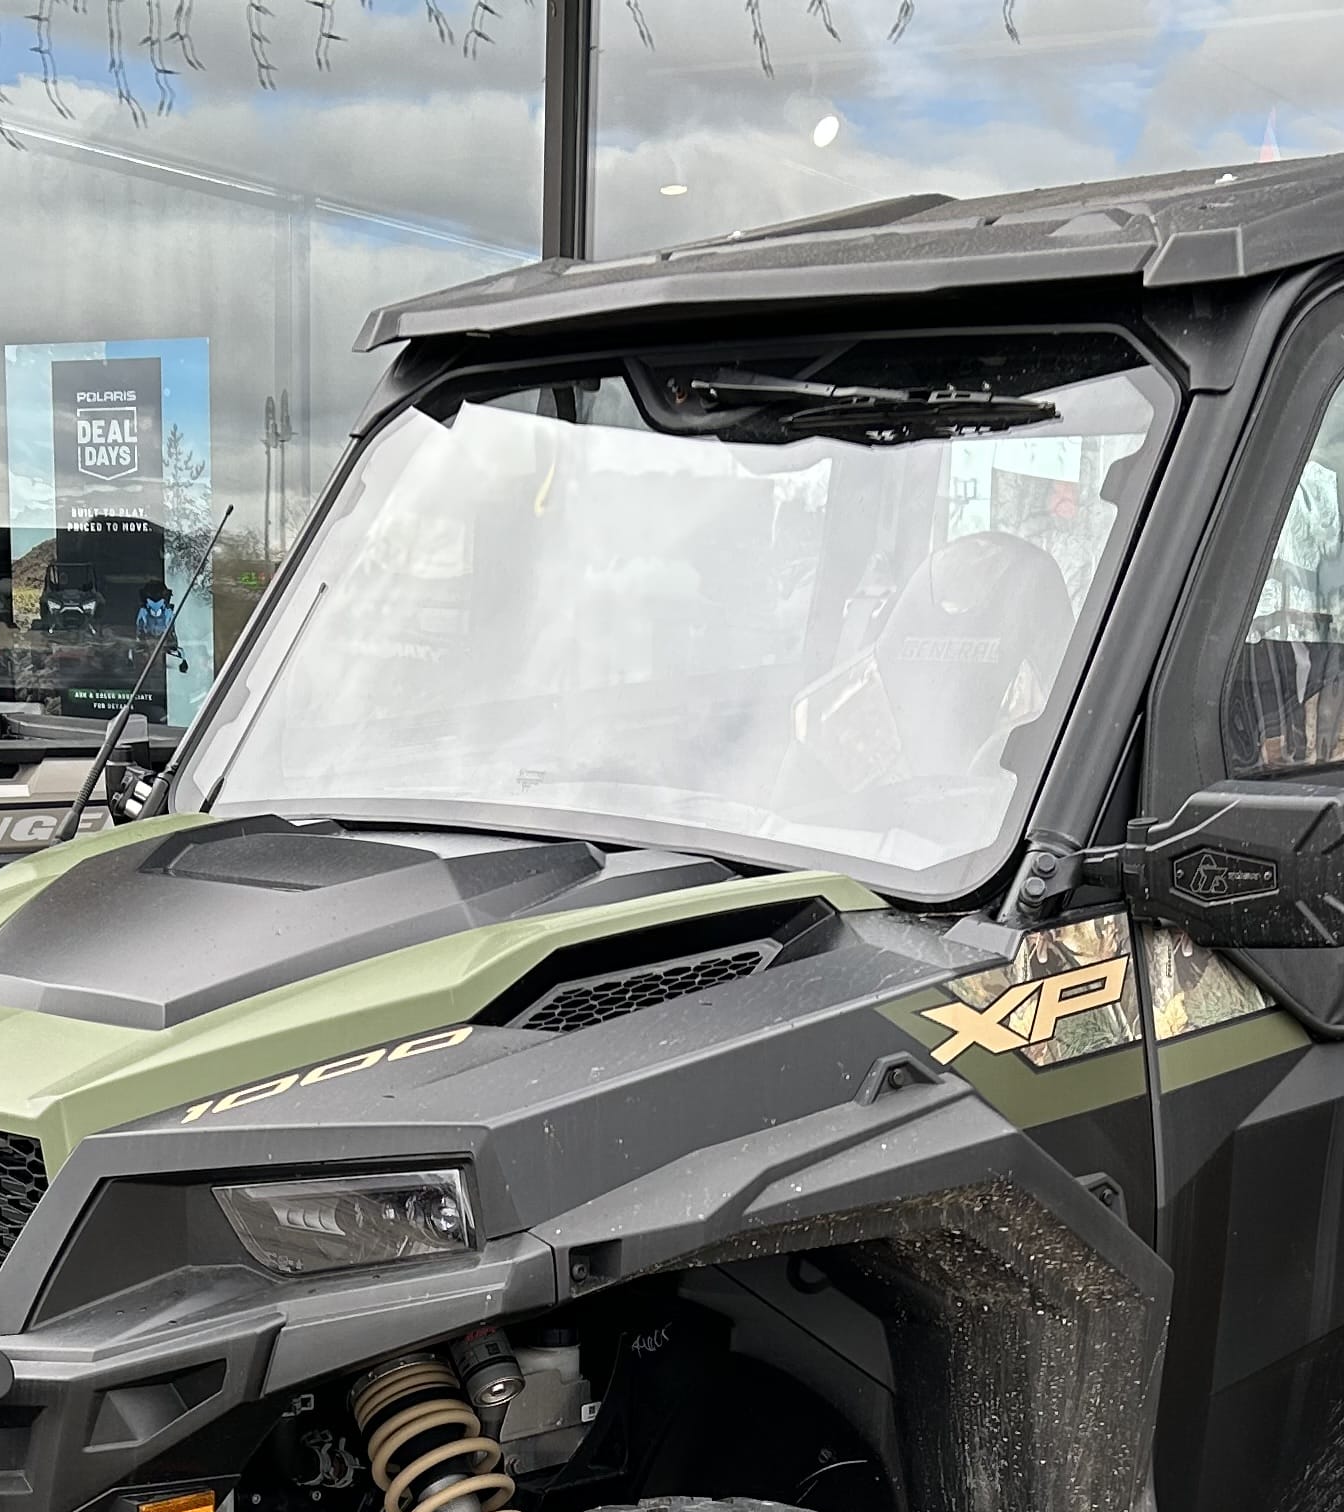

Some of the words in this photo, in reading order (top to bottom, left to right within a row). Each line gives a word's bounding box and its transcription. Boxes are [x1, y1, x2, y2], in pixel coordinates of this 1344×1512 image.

[76, 390, 137, 403] POLARIS
[77, 419, 138, 444] DEAL
[84, 445, 131, 466] DAYS
[71, 507, 98, 518] BUILT
[103, 507, 115, 517] TO
[67, 522, 102, 532] PRICED
[106, 522, 119, 532] TO
[122, 522, 153, 532] MOVE.
[919, 953, 1130, 1066] XP
[180, 1026, 473, 1124] 1000
